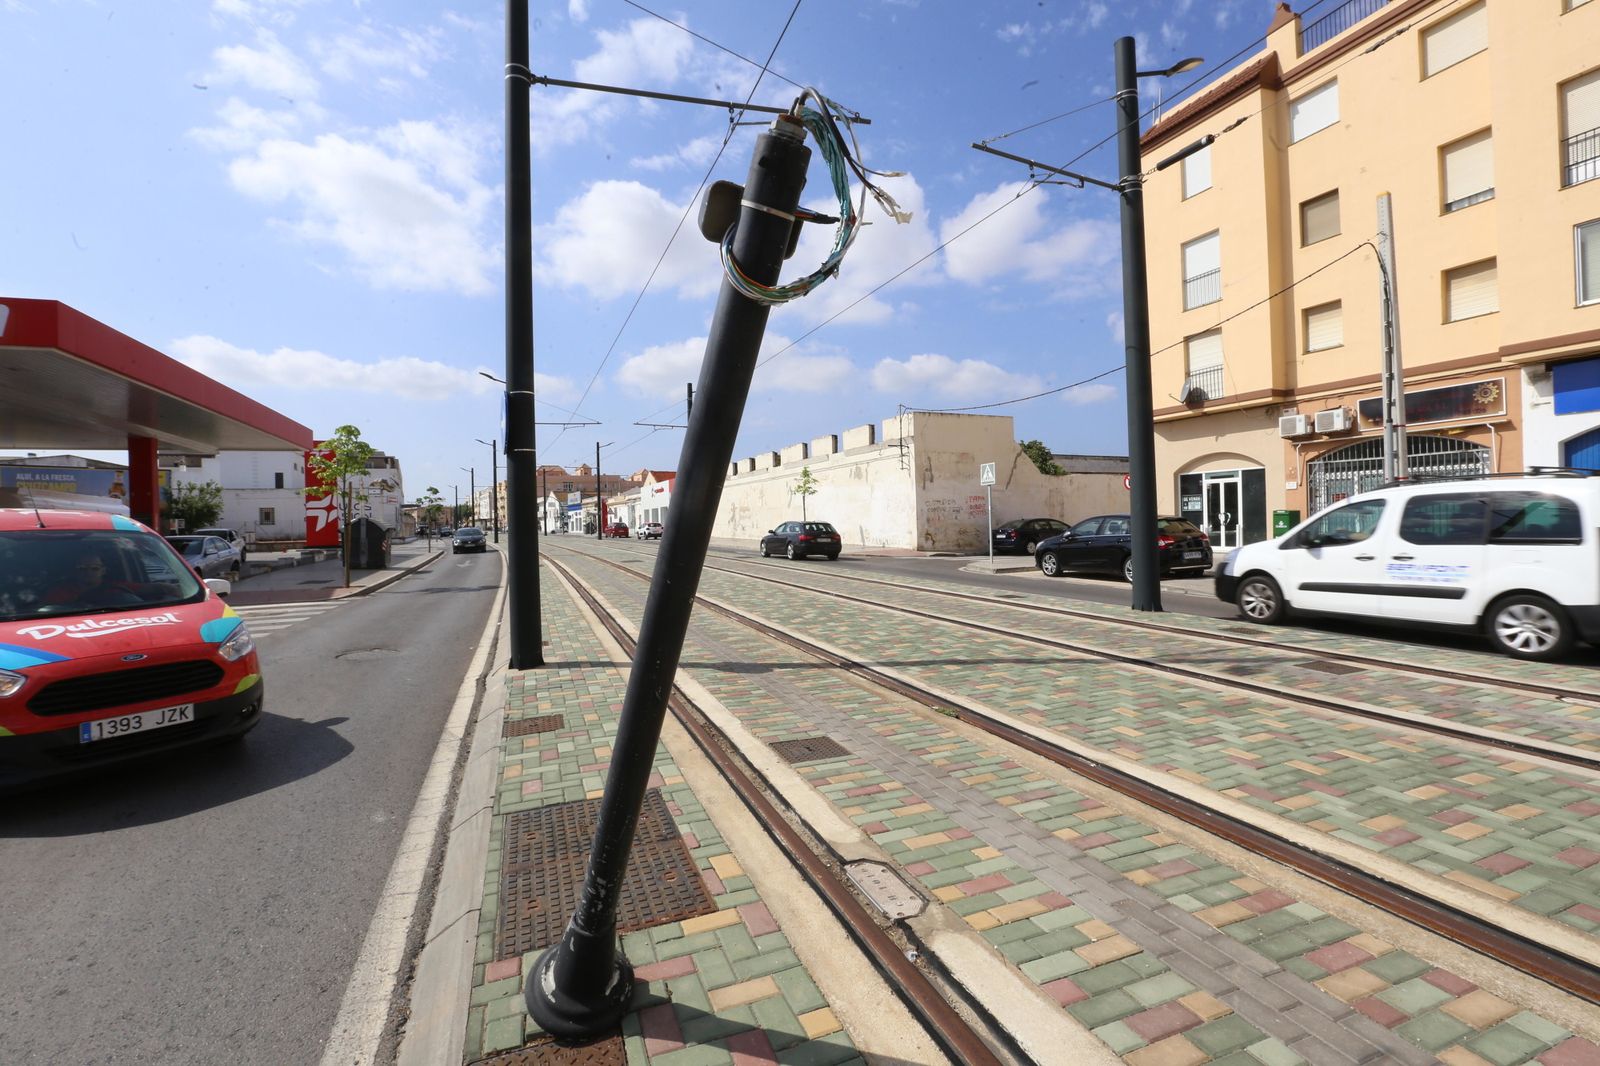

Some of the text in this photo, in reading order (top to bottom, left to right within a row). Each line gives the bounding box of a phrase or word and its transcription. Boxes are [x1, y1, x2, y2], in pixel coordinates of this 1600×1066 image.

[16, 612, 182, 641] Dulcesol
[96, 704, 191, 739] 1393 JZK
